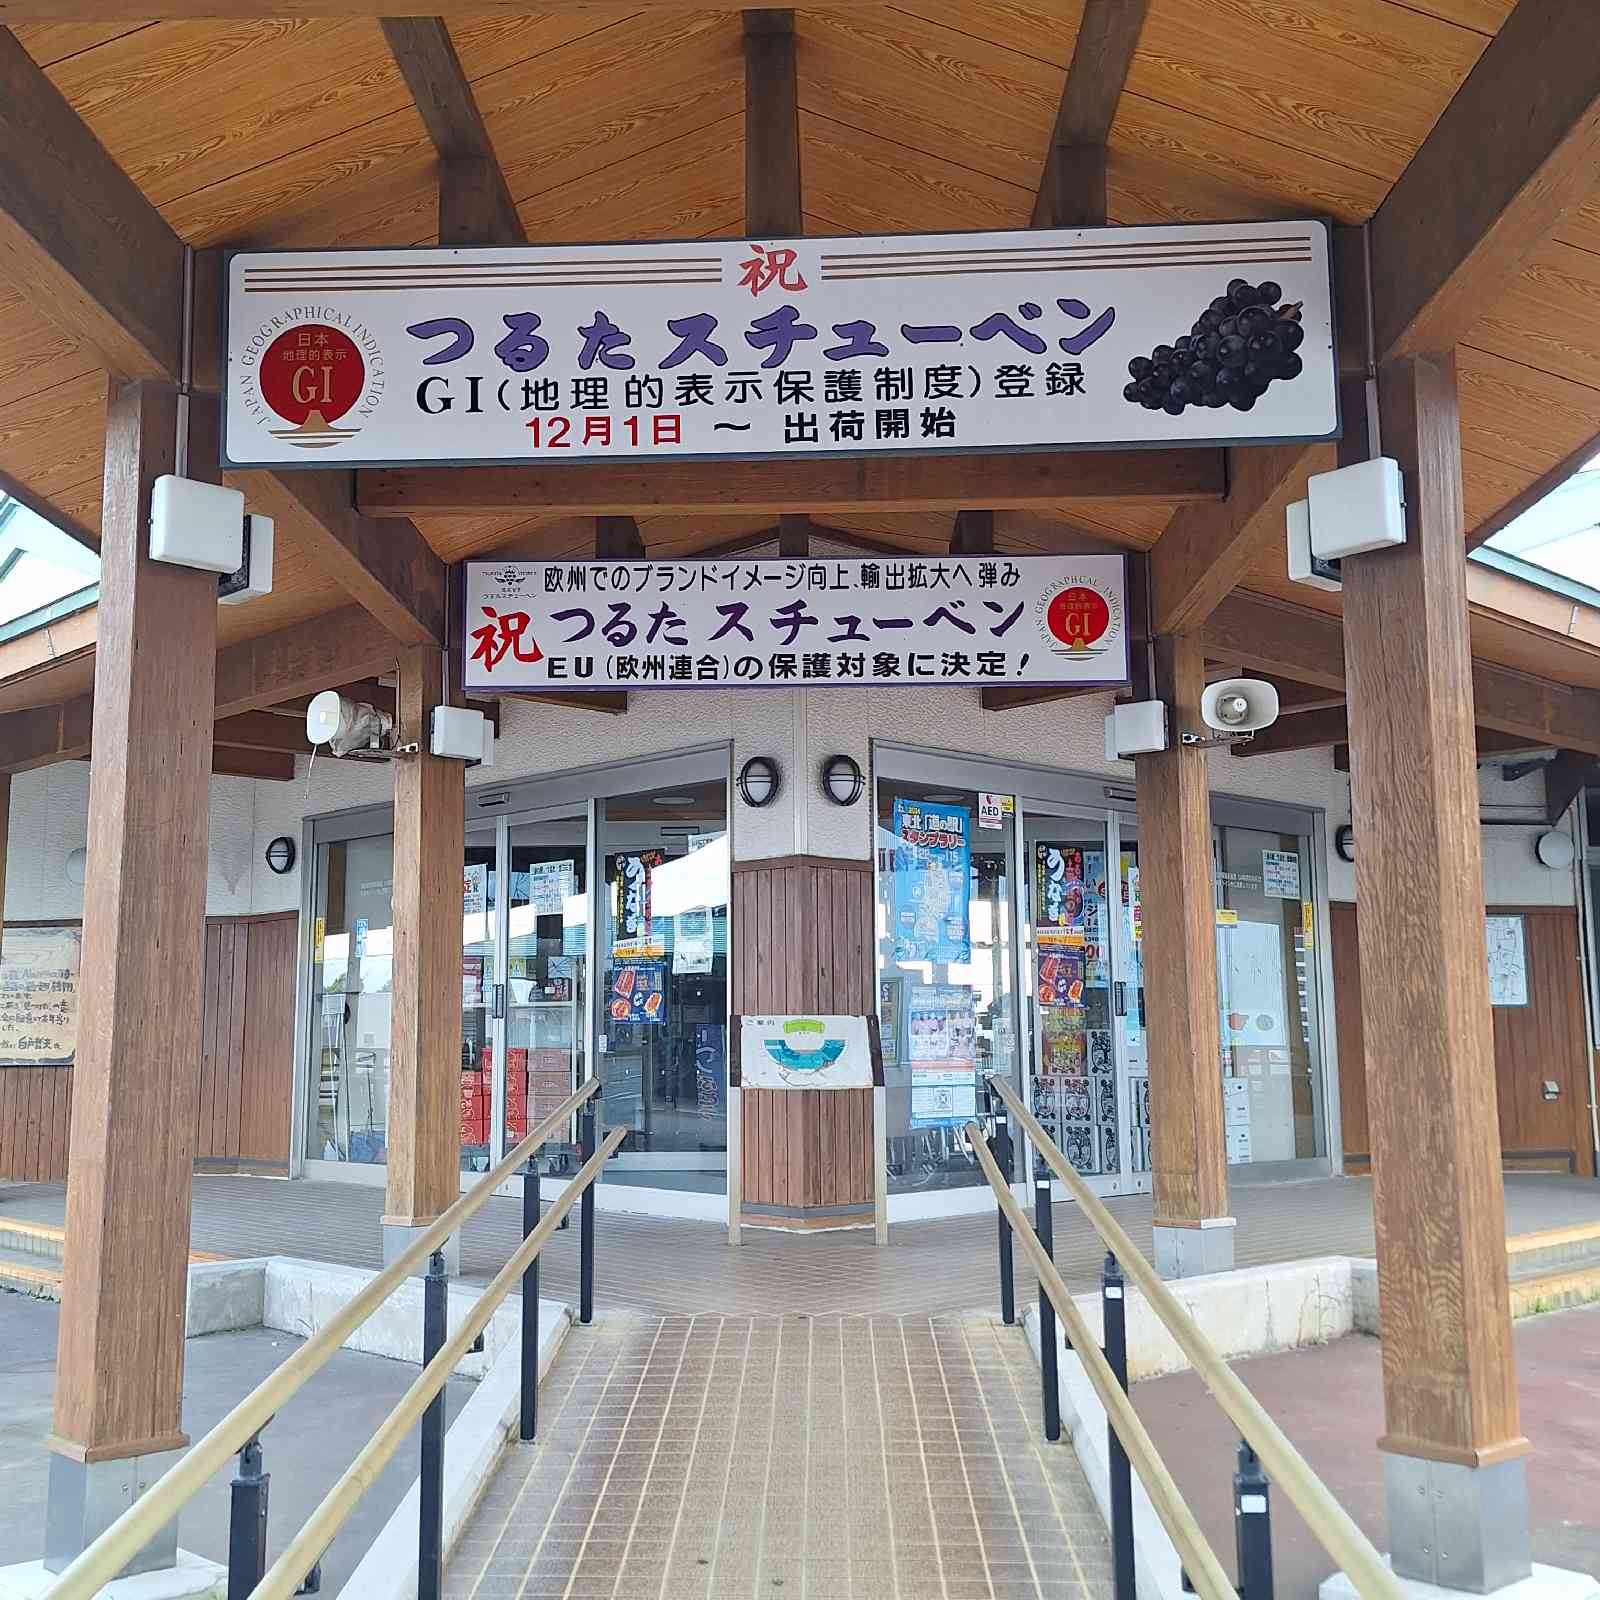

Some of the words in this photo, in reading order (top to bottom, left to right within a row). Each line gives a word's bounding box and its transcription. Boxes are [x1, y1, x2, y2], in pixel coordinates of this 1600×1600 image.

[738, 244, 809, 297] 祝
[241, 306, 352, 367] GEOGRAPHICAL
[282, 349, 348, 361] 地理的表示
[298, 333, 329, 347] 日本
[407, 298, 1116, 373] つるたスチューベン
[292, 365, 333, 404] GI
[352, 323, 385, 418] INDICATION
[240, 375, 271, 425] JAPAN
[524, 414, 683, 449] 12月1日
[784, 406, 956, 444] 出荷開始
[469, 605, 545, 673] 祝
[549, 599, 1026, 648] つるたスチューベン
[1065, 612, 1091, 637] GI
[981, 804, 999, 816] AED
[901, 828, 967, 850] スタンプラリー
